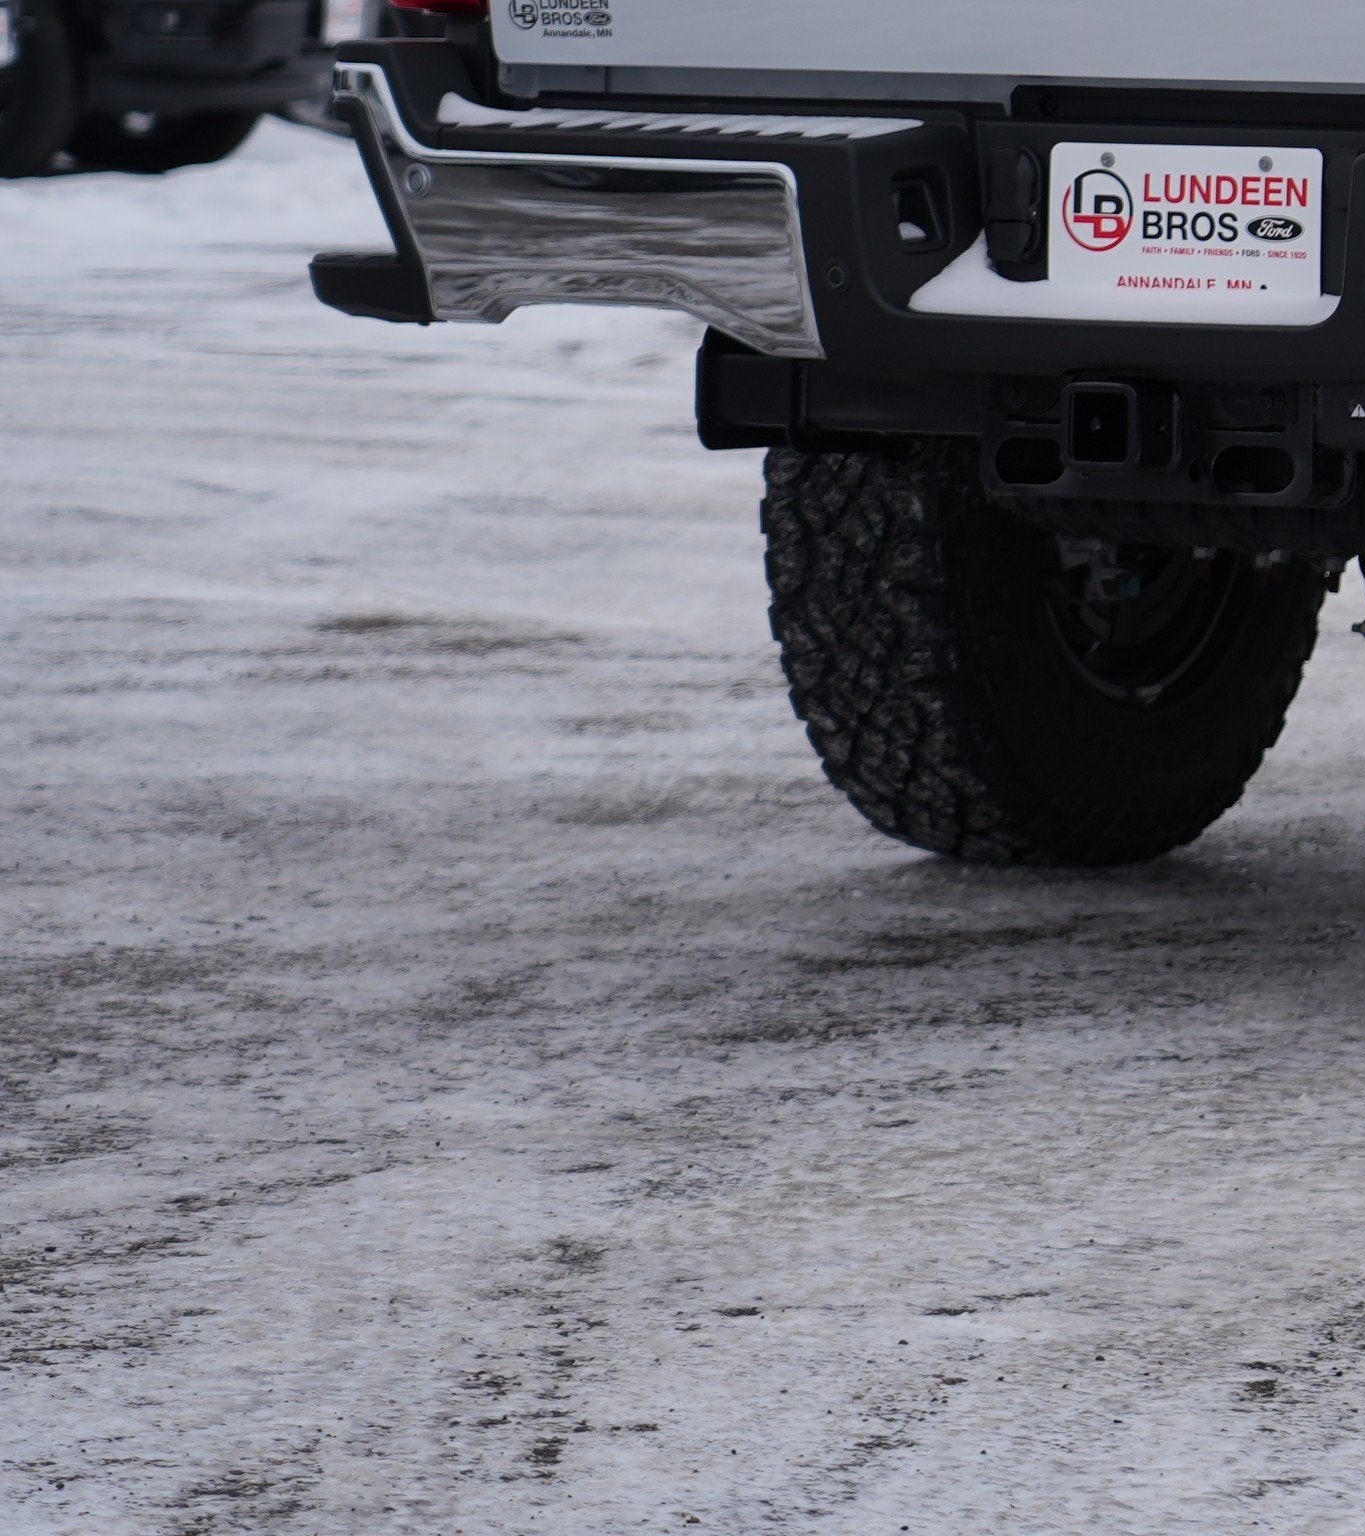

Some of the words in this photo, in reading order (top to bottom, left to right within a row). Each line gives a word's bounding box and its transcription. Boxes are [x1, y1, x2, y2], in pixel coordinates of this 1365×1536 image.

[541, 11, 583, 26] BROS
[597, 28, 612, 37] MN
[1143, 173, 1308, 207] LUNDEEN
[1142, 211, 1239, 242] BROS
[1257, 220, 1293, 239] Ford
[1142, 246, 1162, 255] FAITH
[1170, 247, 1195, 256] FAMILY
[1203, 248, 1234, 257] FRIENDS
[1267, 250, 1288, 259] SINCE
